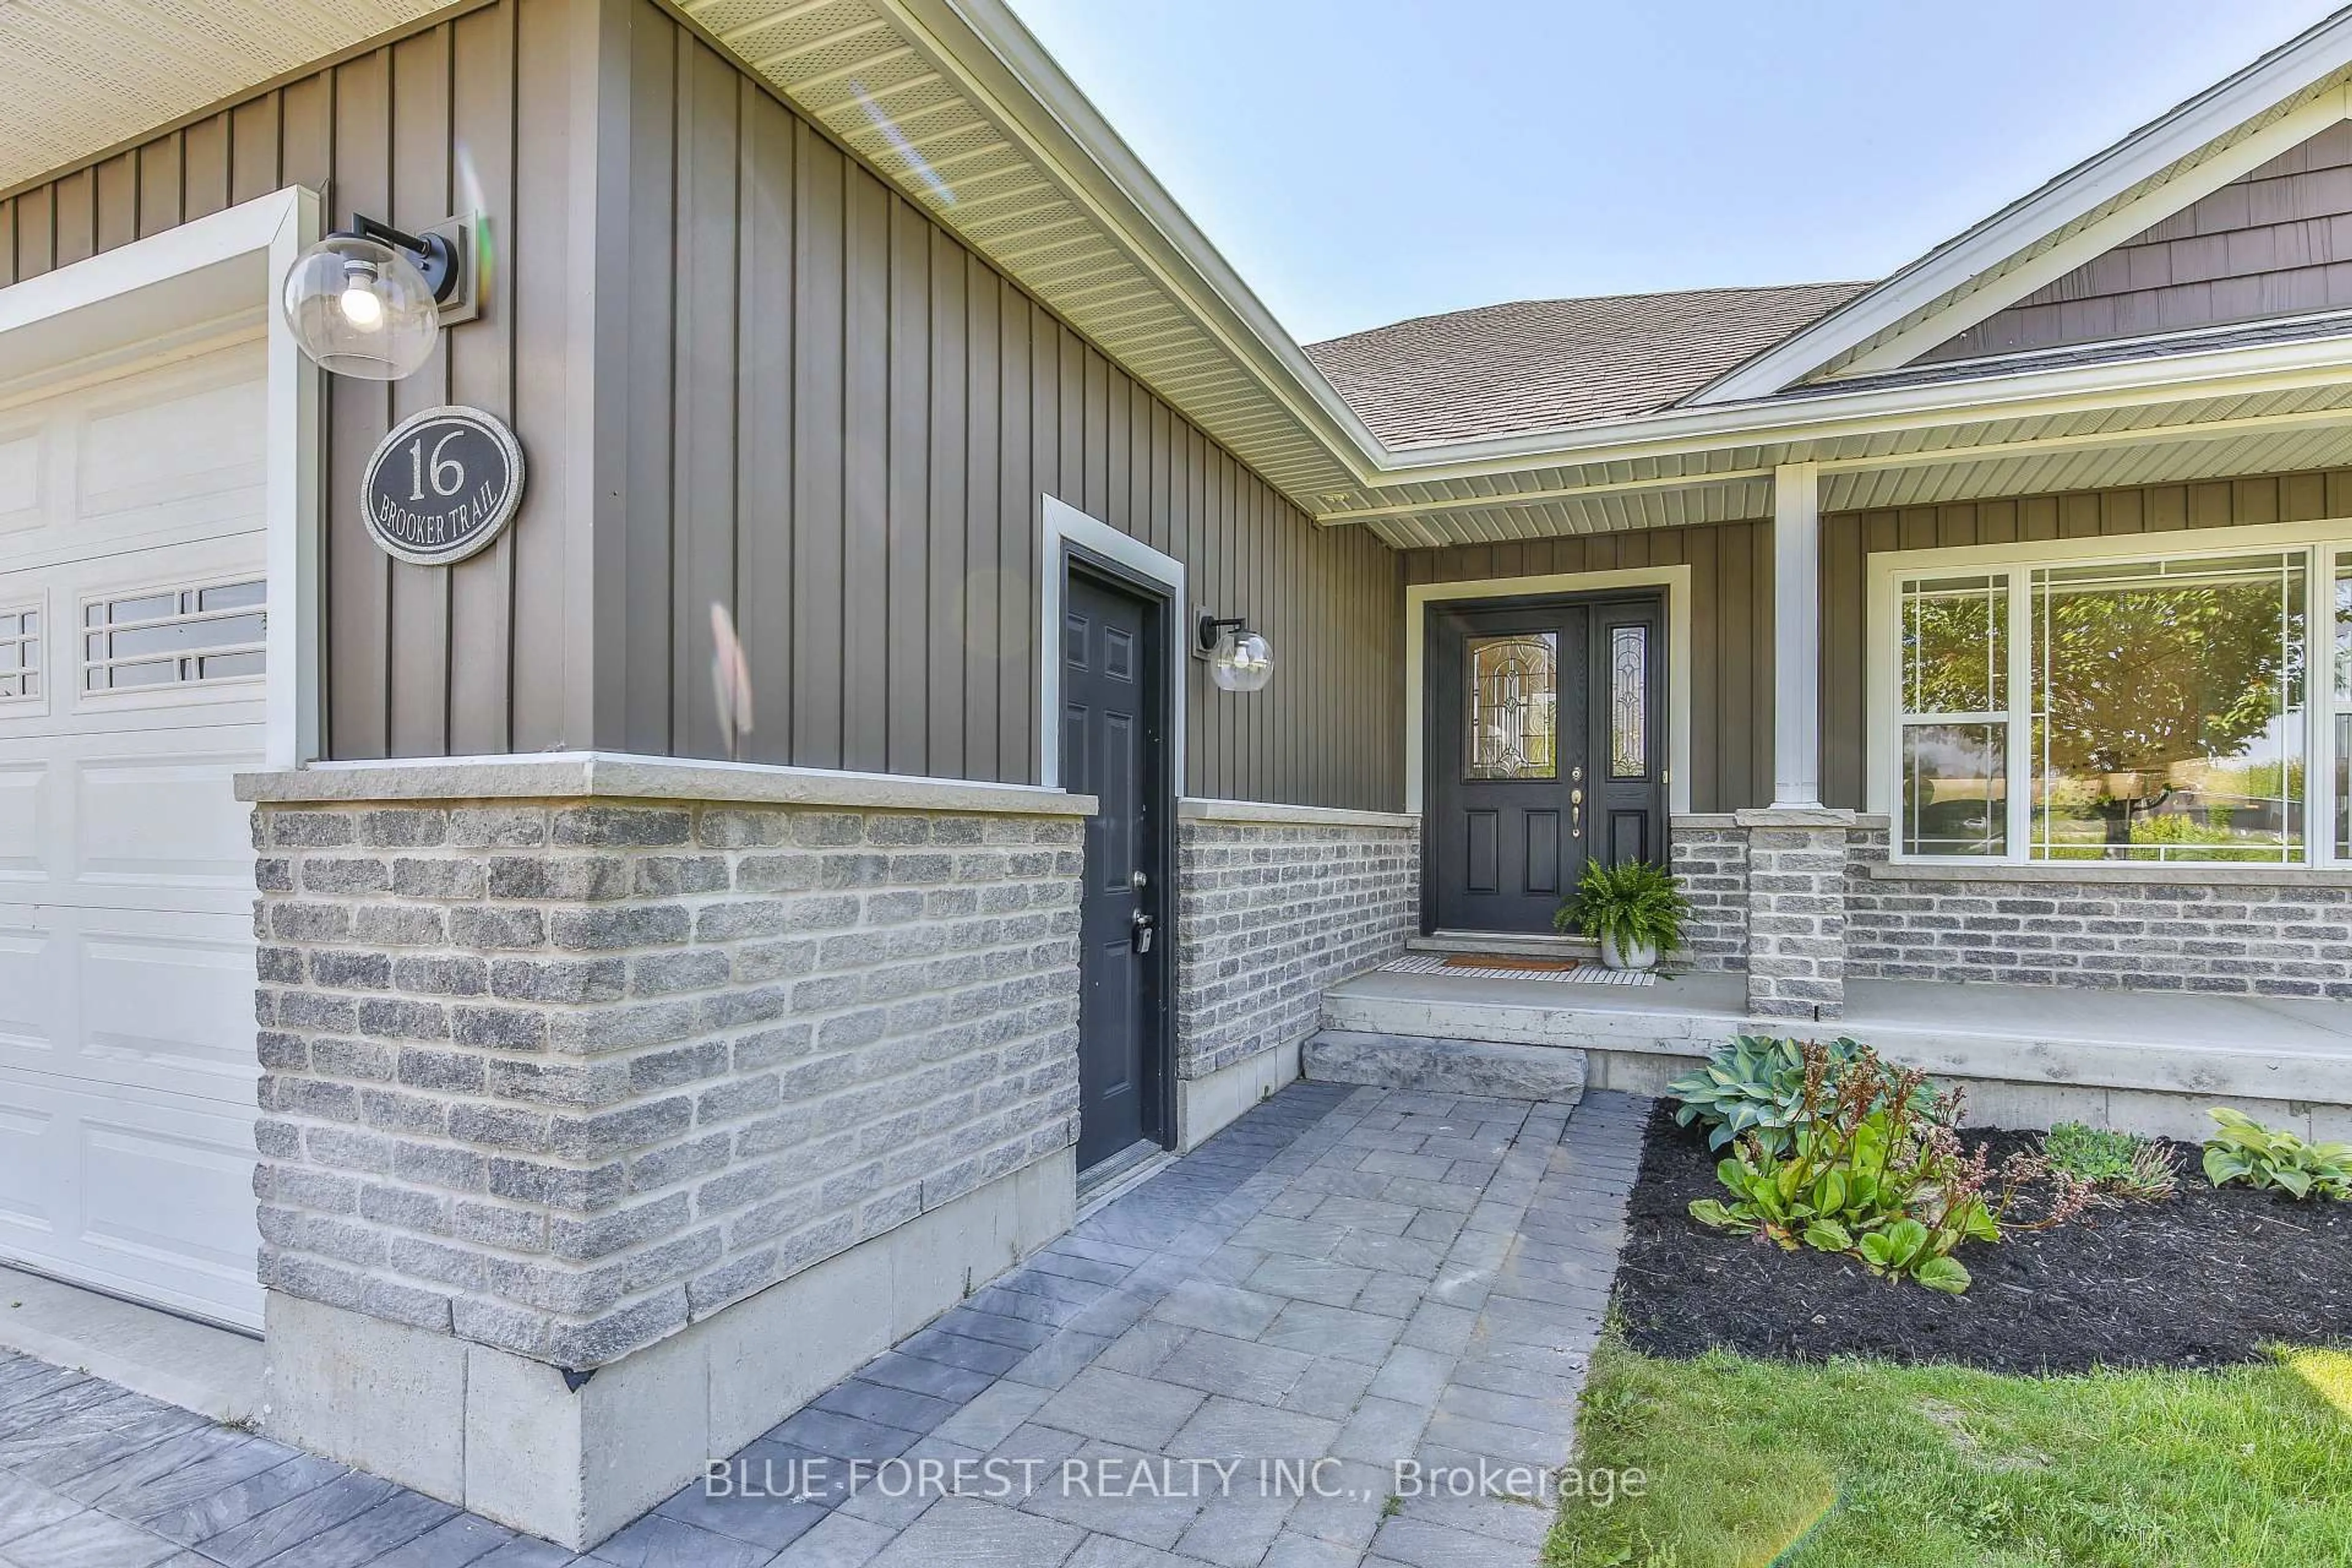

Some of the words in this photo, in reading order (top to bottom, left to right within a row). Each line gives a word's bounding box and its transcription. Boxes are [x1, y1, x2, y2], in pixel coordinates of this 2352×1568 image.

[409, 430, 464, 500] 16
[380, 494, 445, 543] BROOKER
[448, 480, 497, 537] TRAIL
